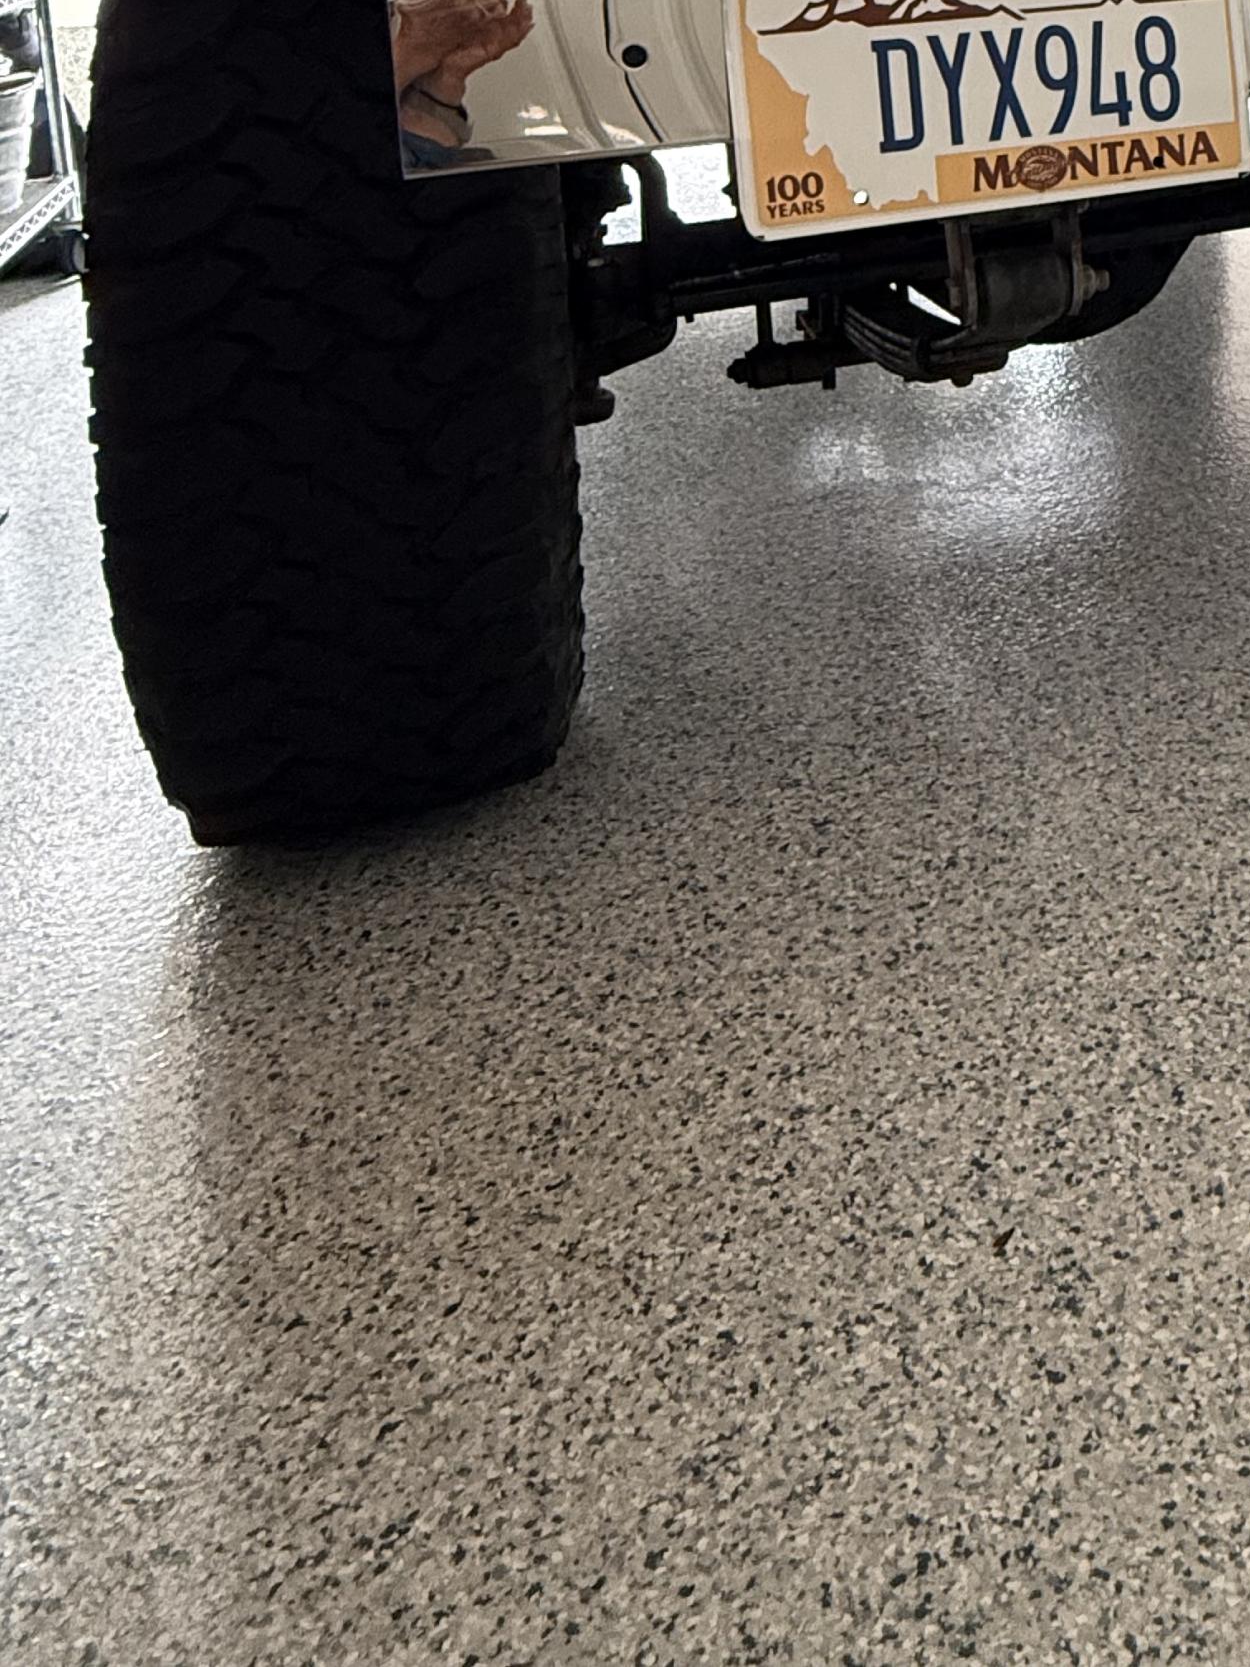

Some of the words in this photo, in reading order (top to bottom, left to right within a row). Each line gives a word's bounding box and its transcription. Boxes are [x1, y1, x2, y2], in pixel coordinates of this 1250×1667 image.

[871, 15, 1181, 153] DYX948
[973, 131, 1219, 192] MONTANA
[766, 171, 824, 203] 100
[766, 198, 825, 219] YEARS
